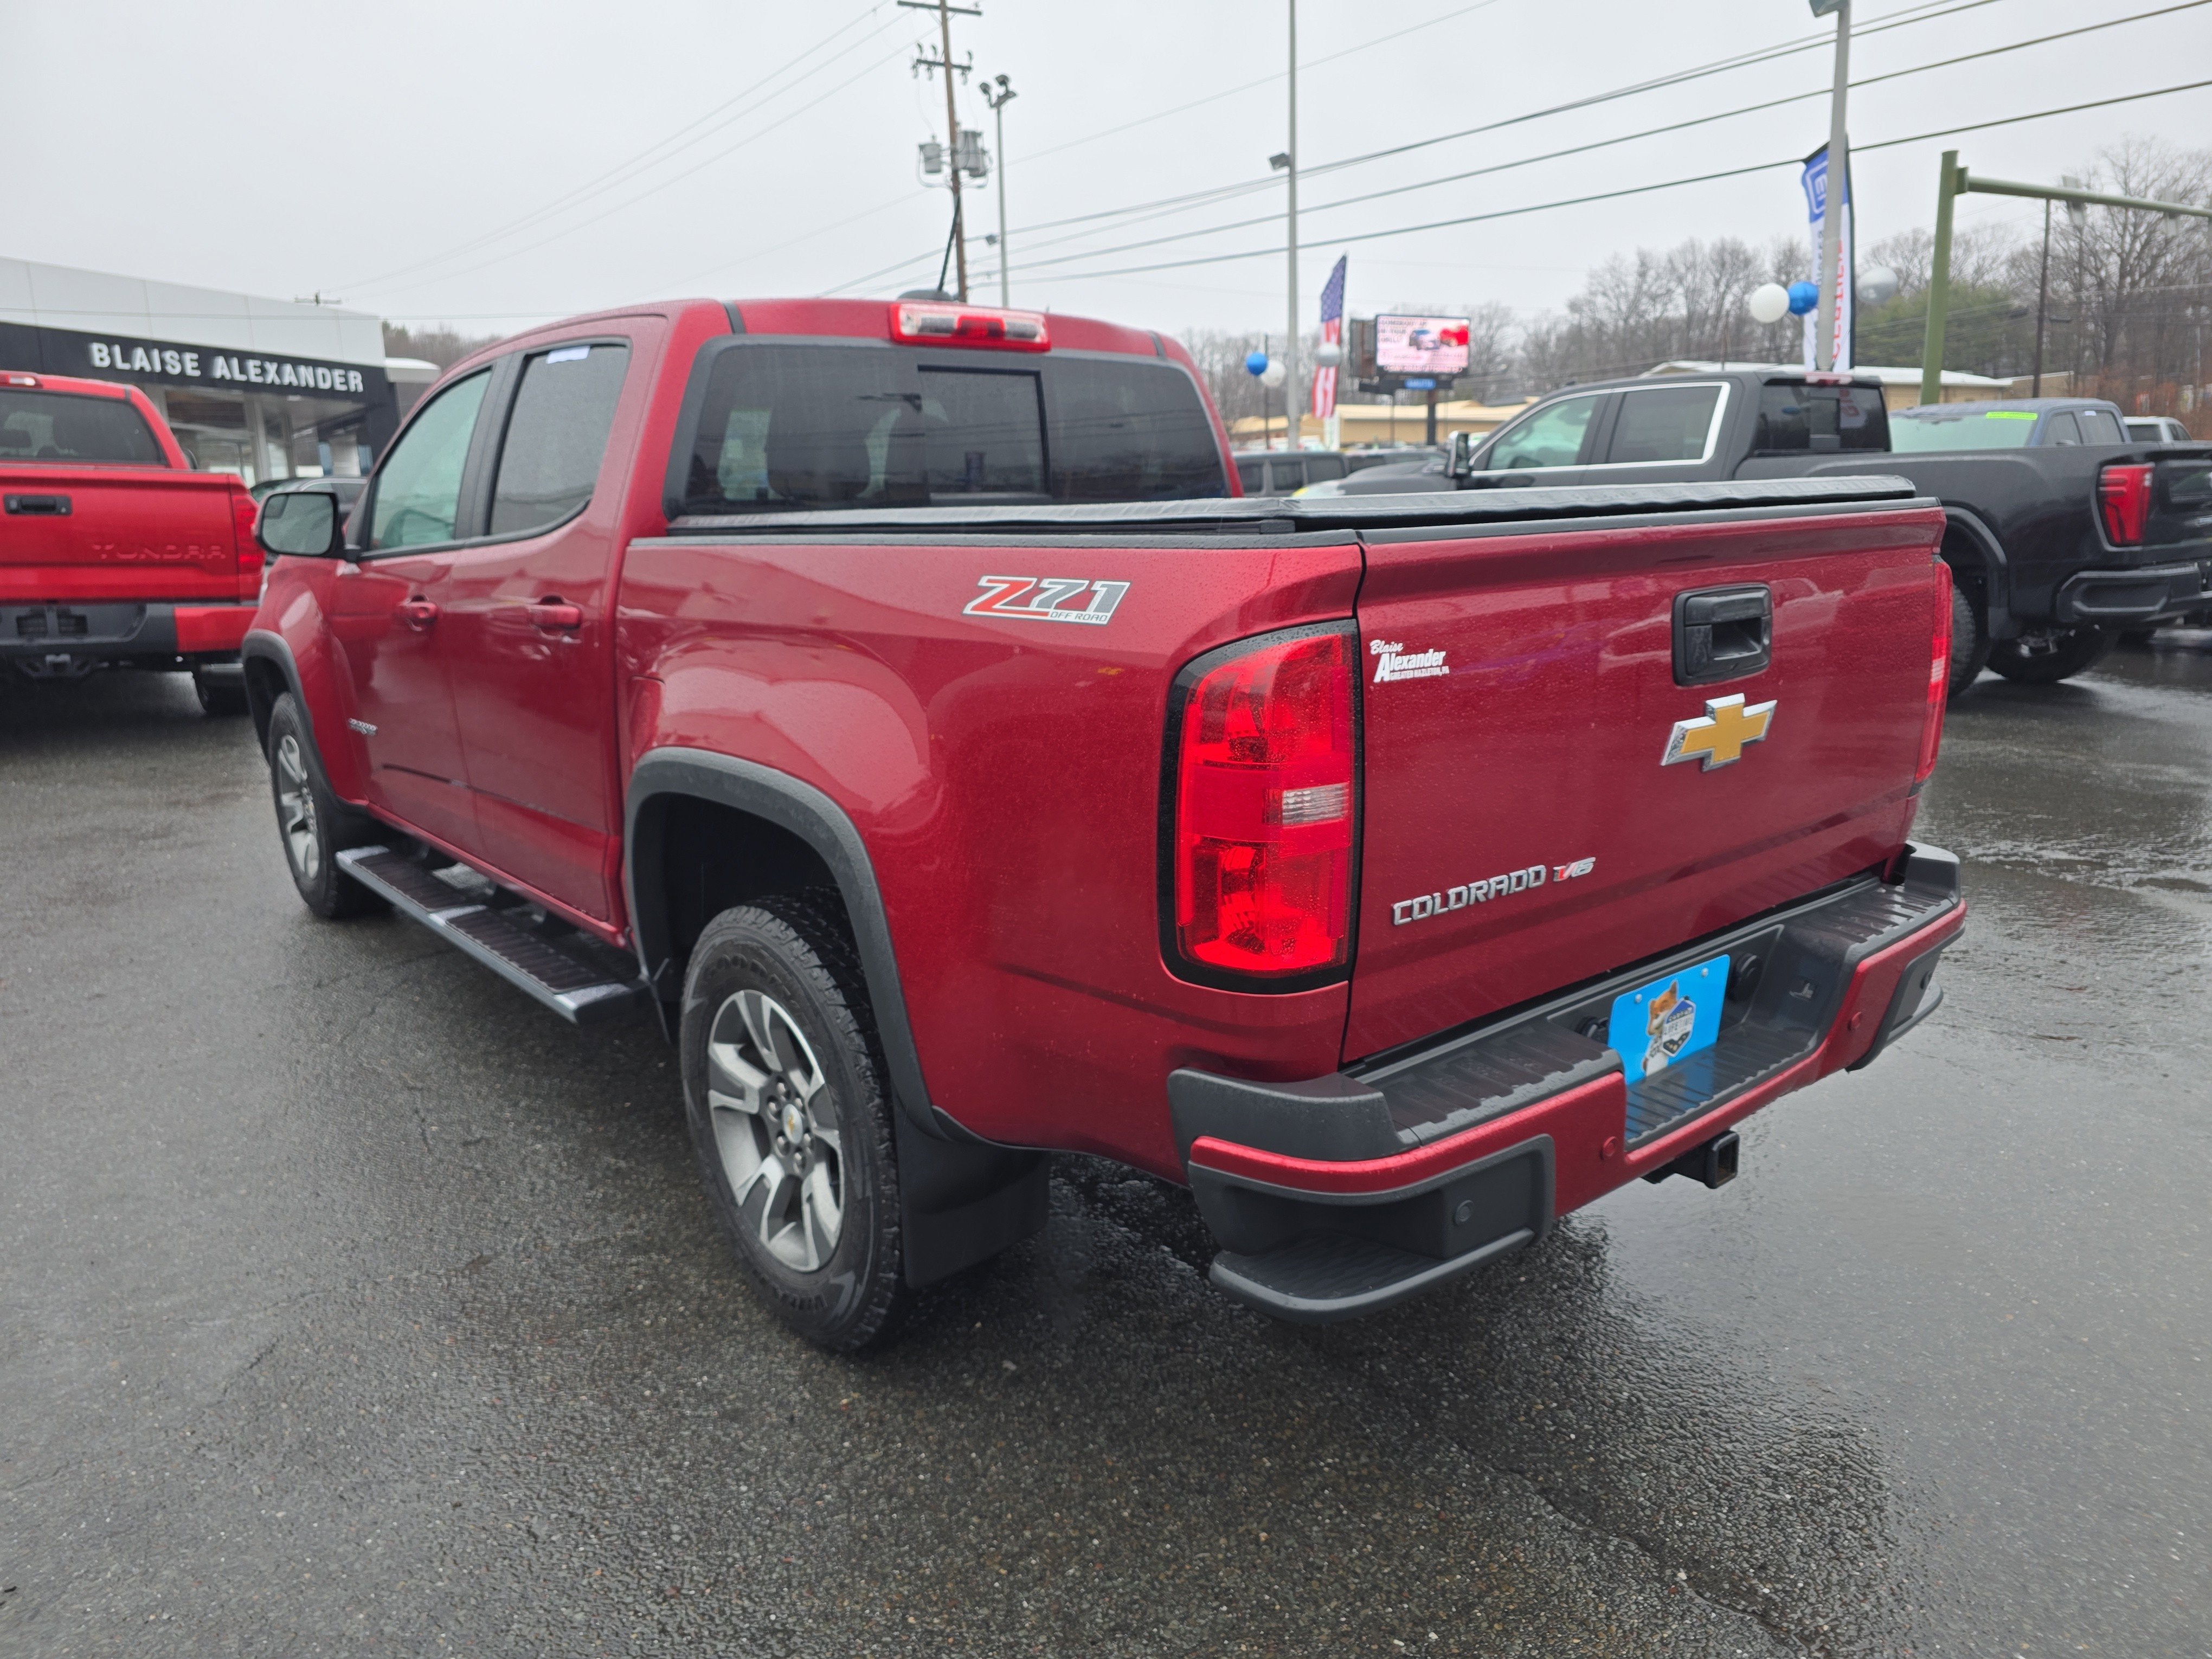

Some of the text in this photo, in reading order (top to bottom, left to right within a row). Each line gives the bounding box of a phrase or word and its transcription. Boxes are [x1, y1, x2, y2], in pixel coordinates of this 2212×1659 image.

[89, 342, 364, 393] BLAISE ALEXANDER
[92, 543, 226, 559] TUNDRA
[962, 575, 1131, 618] Z71
[1050, 611, 1108, 622] OFF ROAD
[1369, 639, 1404, 655] Blaise
[1373, 648, 1446, 683] Alexander
[1392, 857, 1596, 926] COLORADO V6
